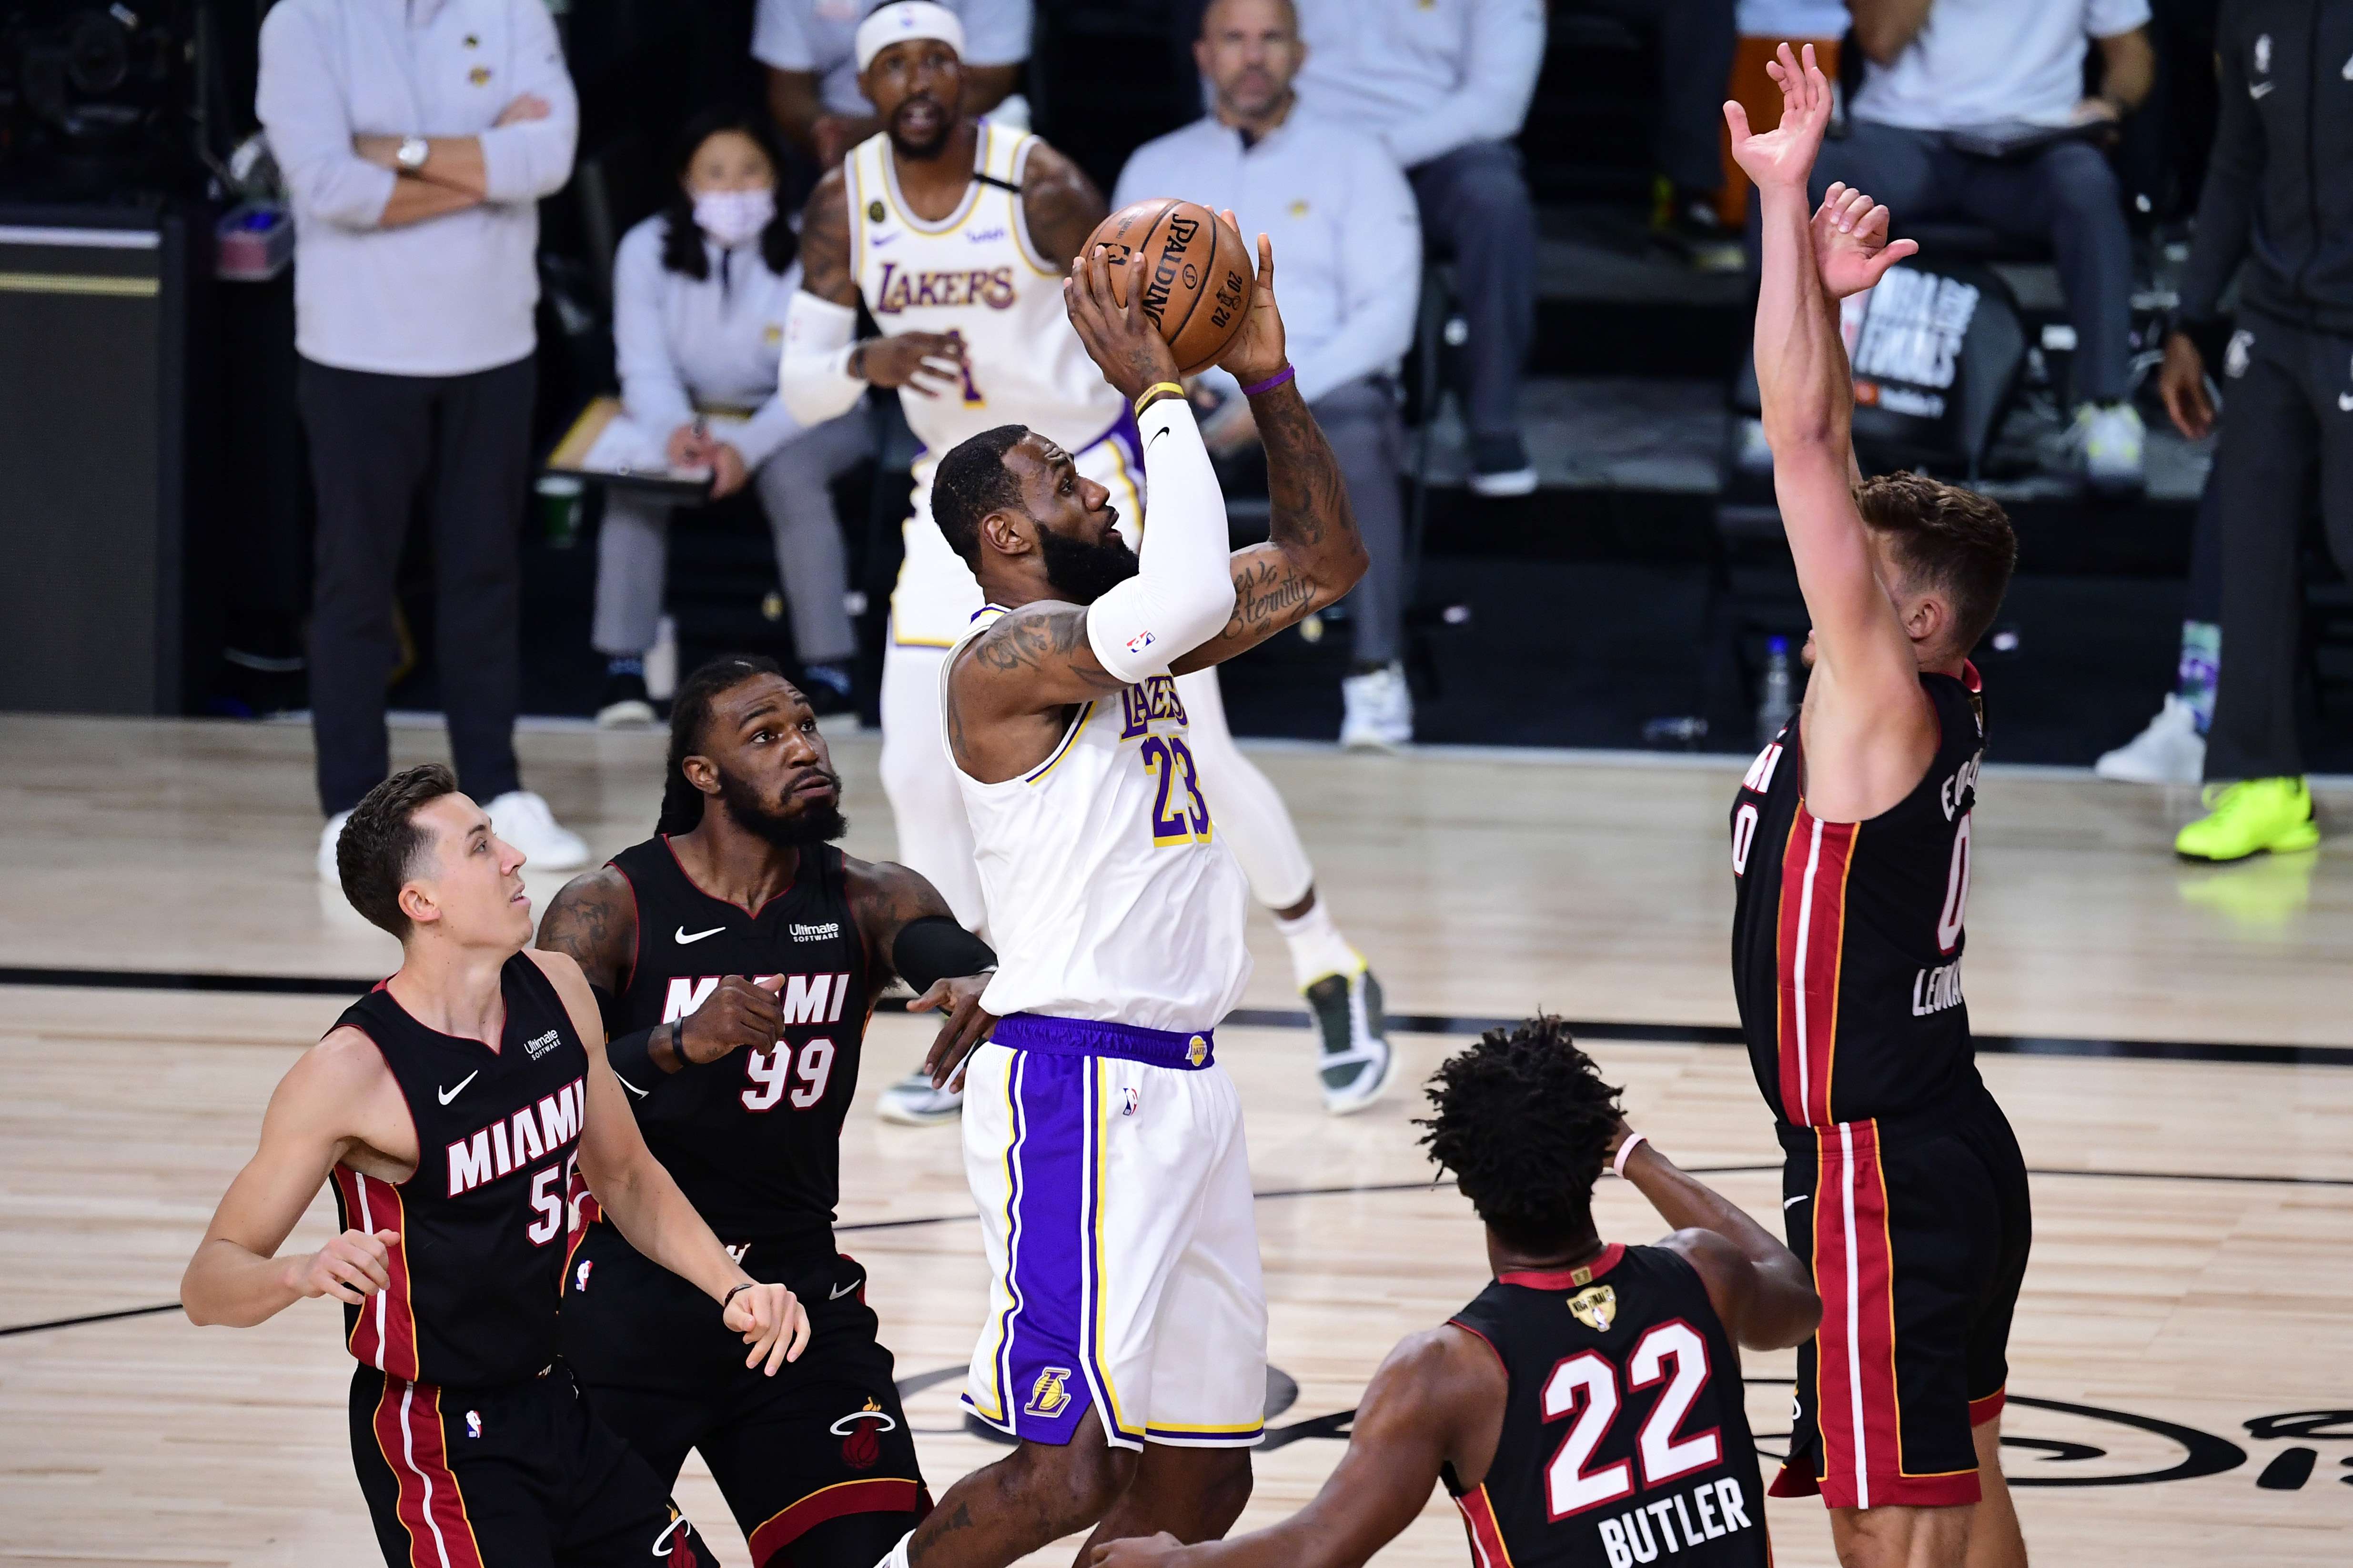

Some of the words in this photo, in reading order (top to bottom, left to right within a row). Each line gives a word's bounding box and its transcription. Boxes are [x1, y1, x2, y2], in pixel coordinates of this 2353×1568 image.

[878, 261, 1017, 315] LAKERS
[1226, 270, 1243, 294] 20
[1211, 306, 1231, 328] 20
[1141, 733, 1213, 848] 23
[1732, 802, 1758, 878] 0
[789, 923, 838, 936] Ultimate
[793, 932, 838, 942] SOFTWARE
[661, 971, 853, 1027] MMI
[524, 1029, 558, 1054] Ultimate
[531, 1038, 561, 1061] SOFTWARE
[739, 1035, 838, 1113] 99
[446, 1075, 585, 1199] MIAMI
[1540, 1317, 1724, 1524] 22
[1598, 1477, 1752, 1568] BUTLER
